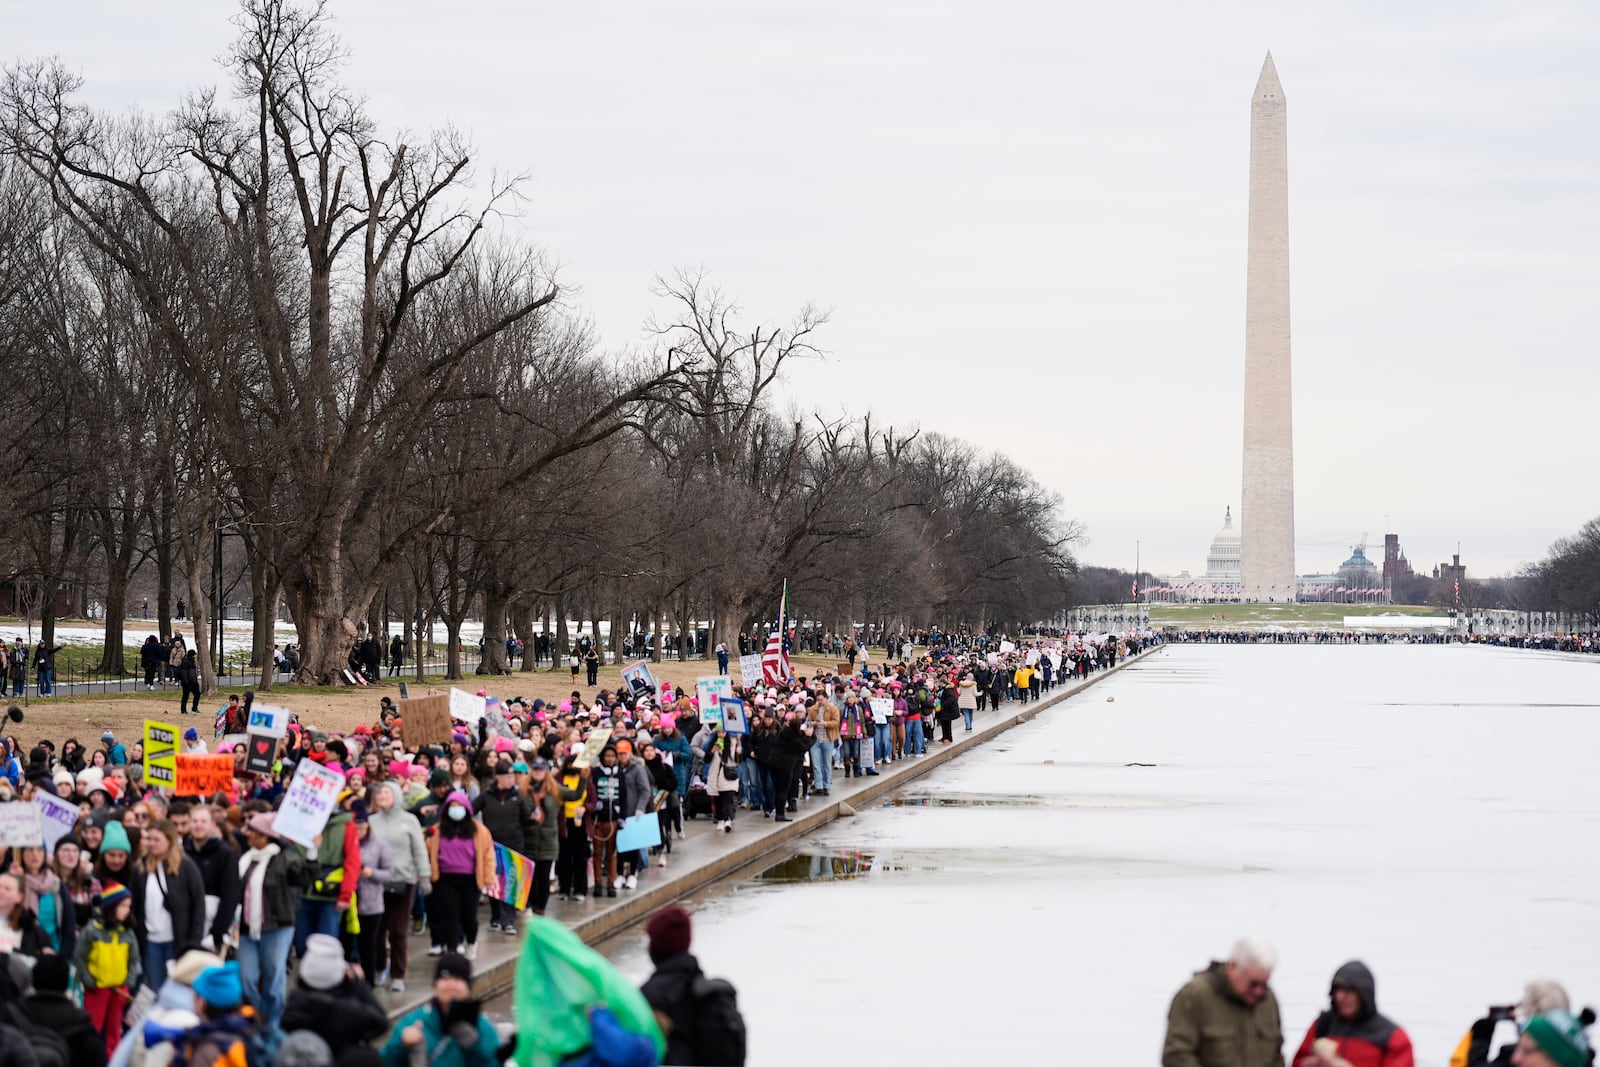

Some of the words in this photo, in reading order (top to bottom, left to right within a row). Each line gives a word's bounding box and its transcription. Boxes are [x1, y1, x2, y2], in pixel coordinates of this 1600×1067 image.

[150, 727, 174, 743] STOP
[408, 727, 445, 744] GIRL
[212, 758, 232, 771] ALL
[150, 765, 173, 781] HATE
